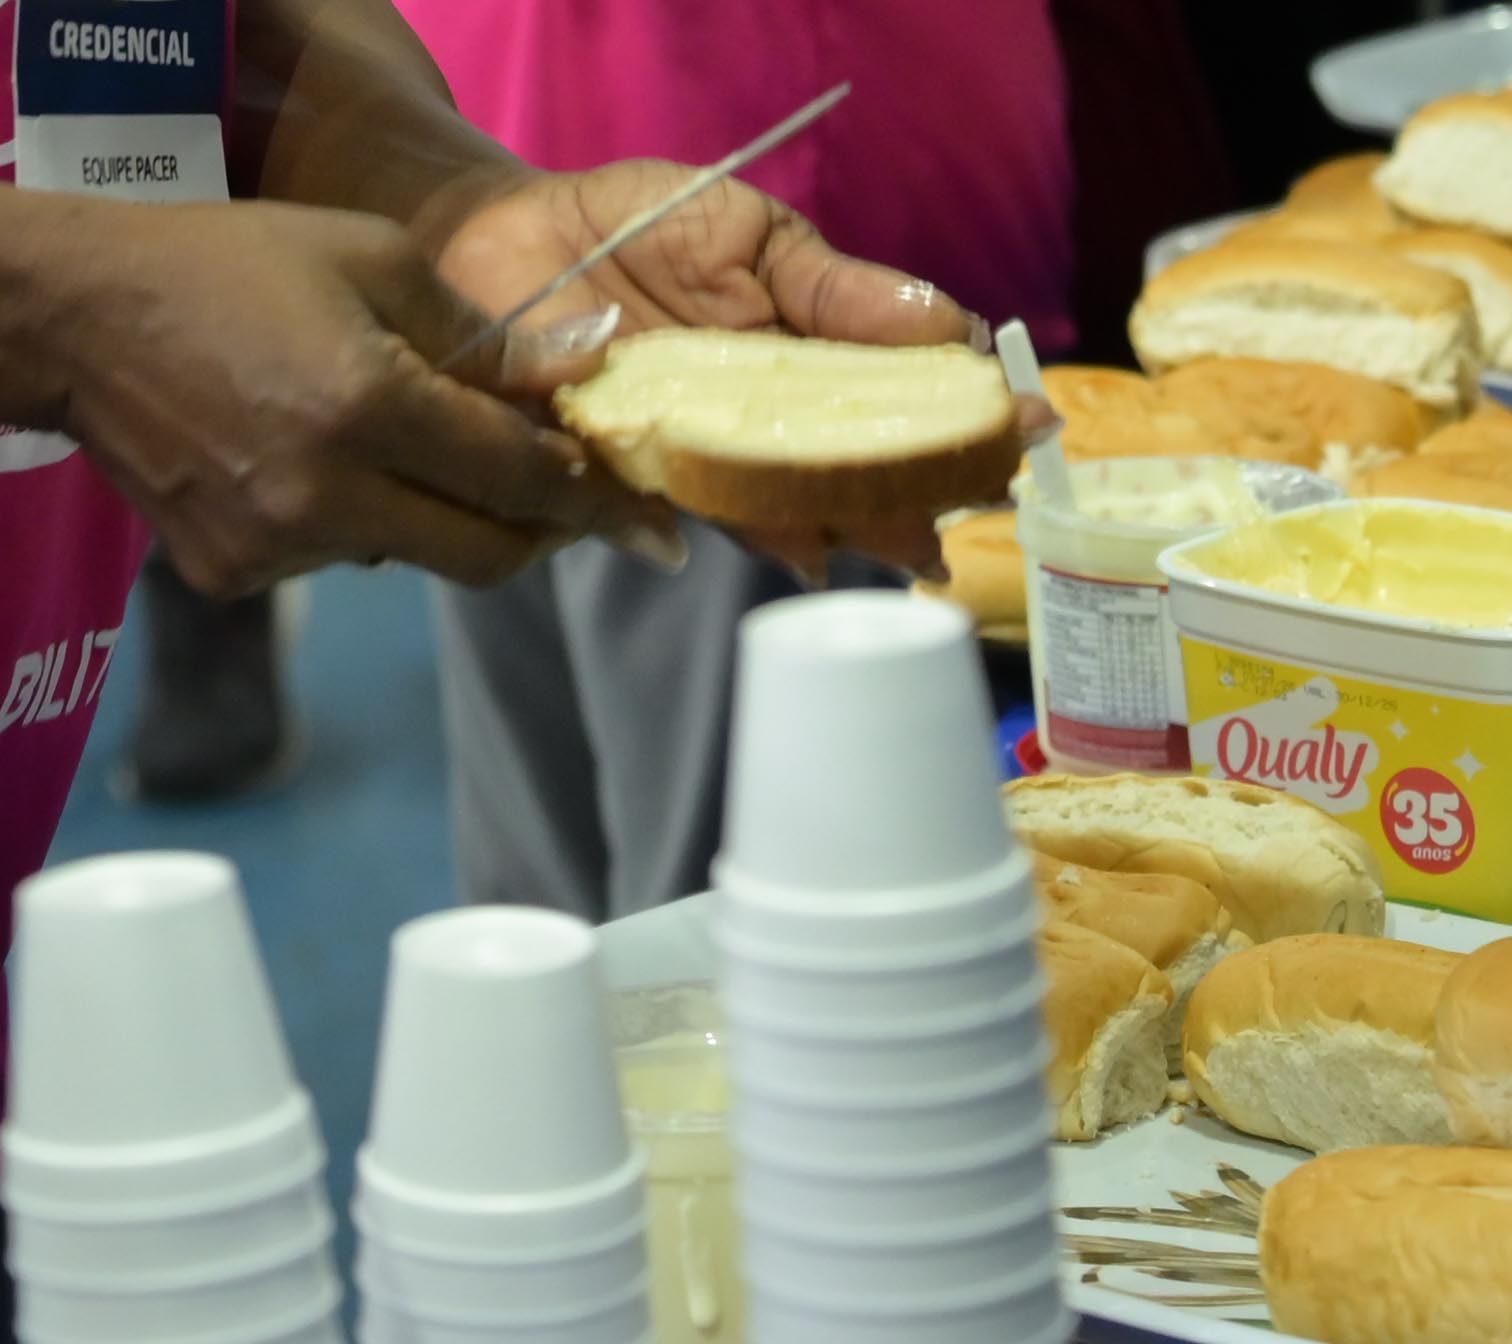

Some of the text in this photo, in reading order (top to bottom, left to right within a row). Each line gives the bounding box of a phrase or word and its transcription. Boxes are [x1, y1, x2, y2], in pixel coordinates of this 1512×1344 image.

[49, 19, 195, 67] CREDENCIAL
[82, 154, 179, 186] EQUIPE PACER
[1217, 717, 1369, 800] Qualy
[1392, 789, 1463, 846] 35
[1412, 846, 1452, 861] anos
